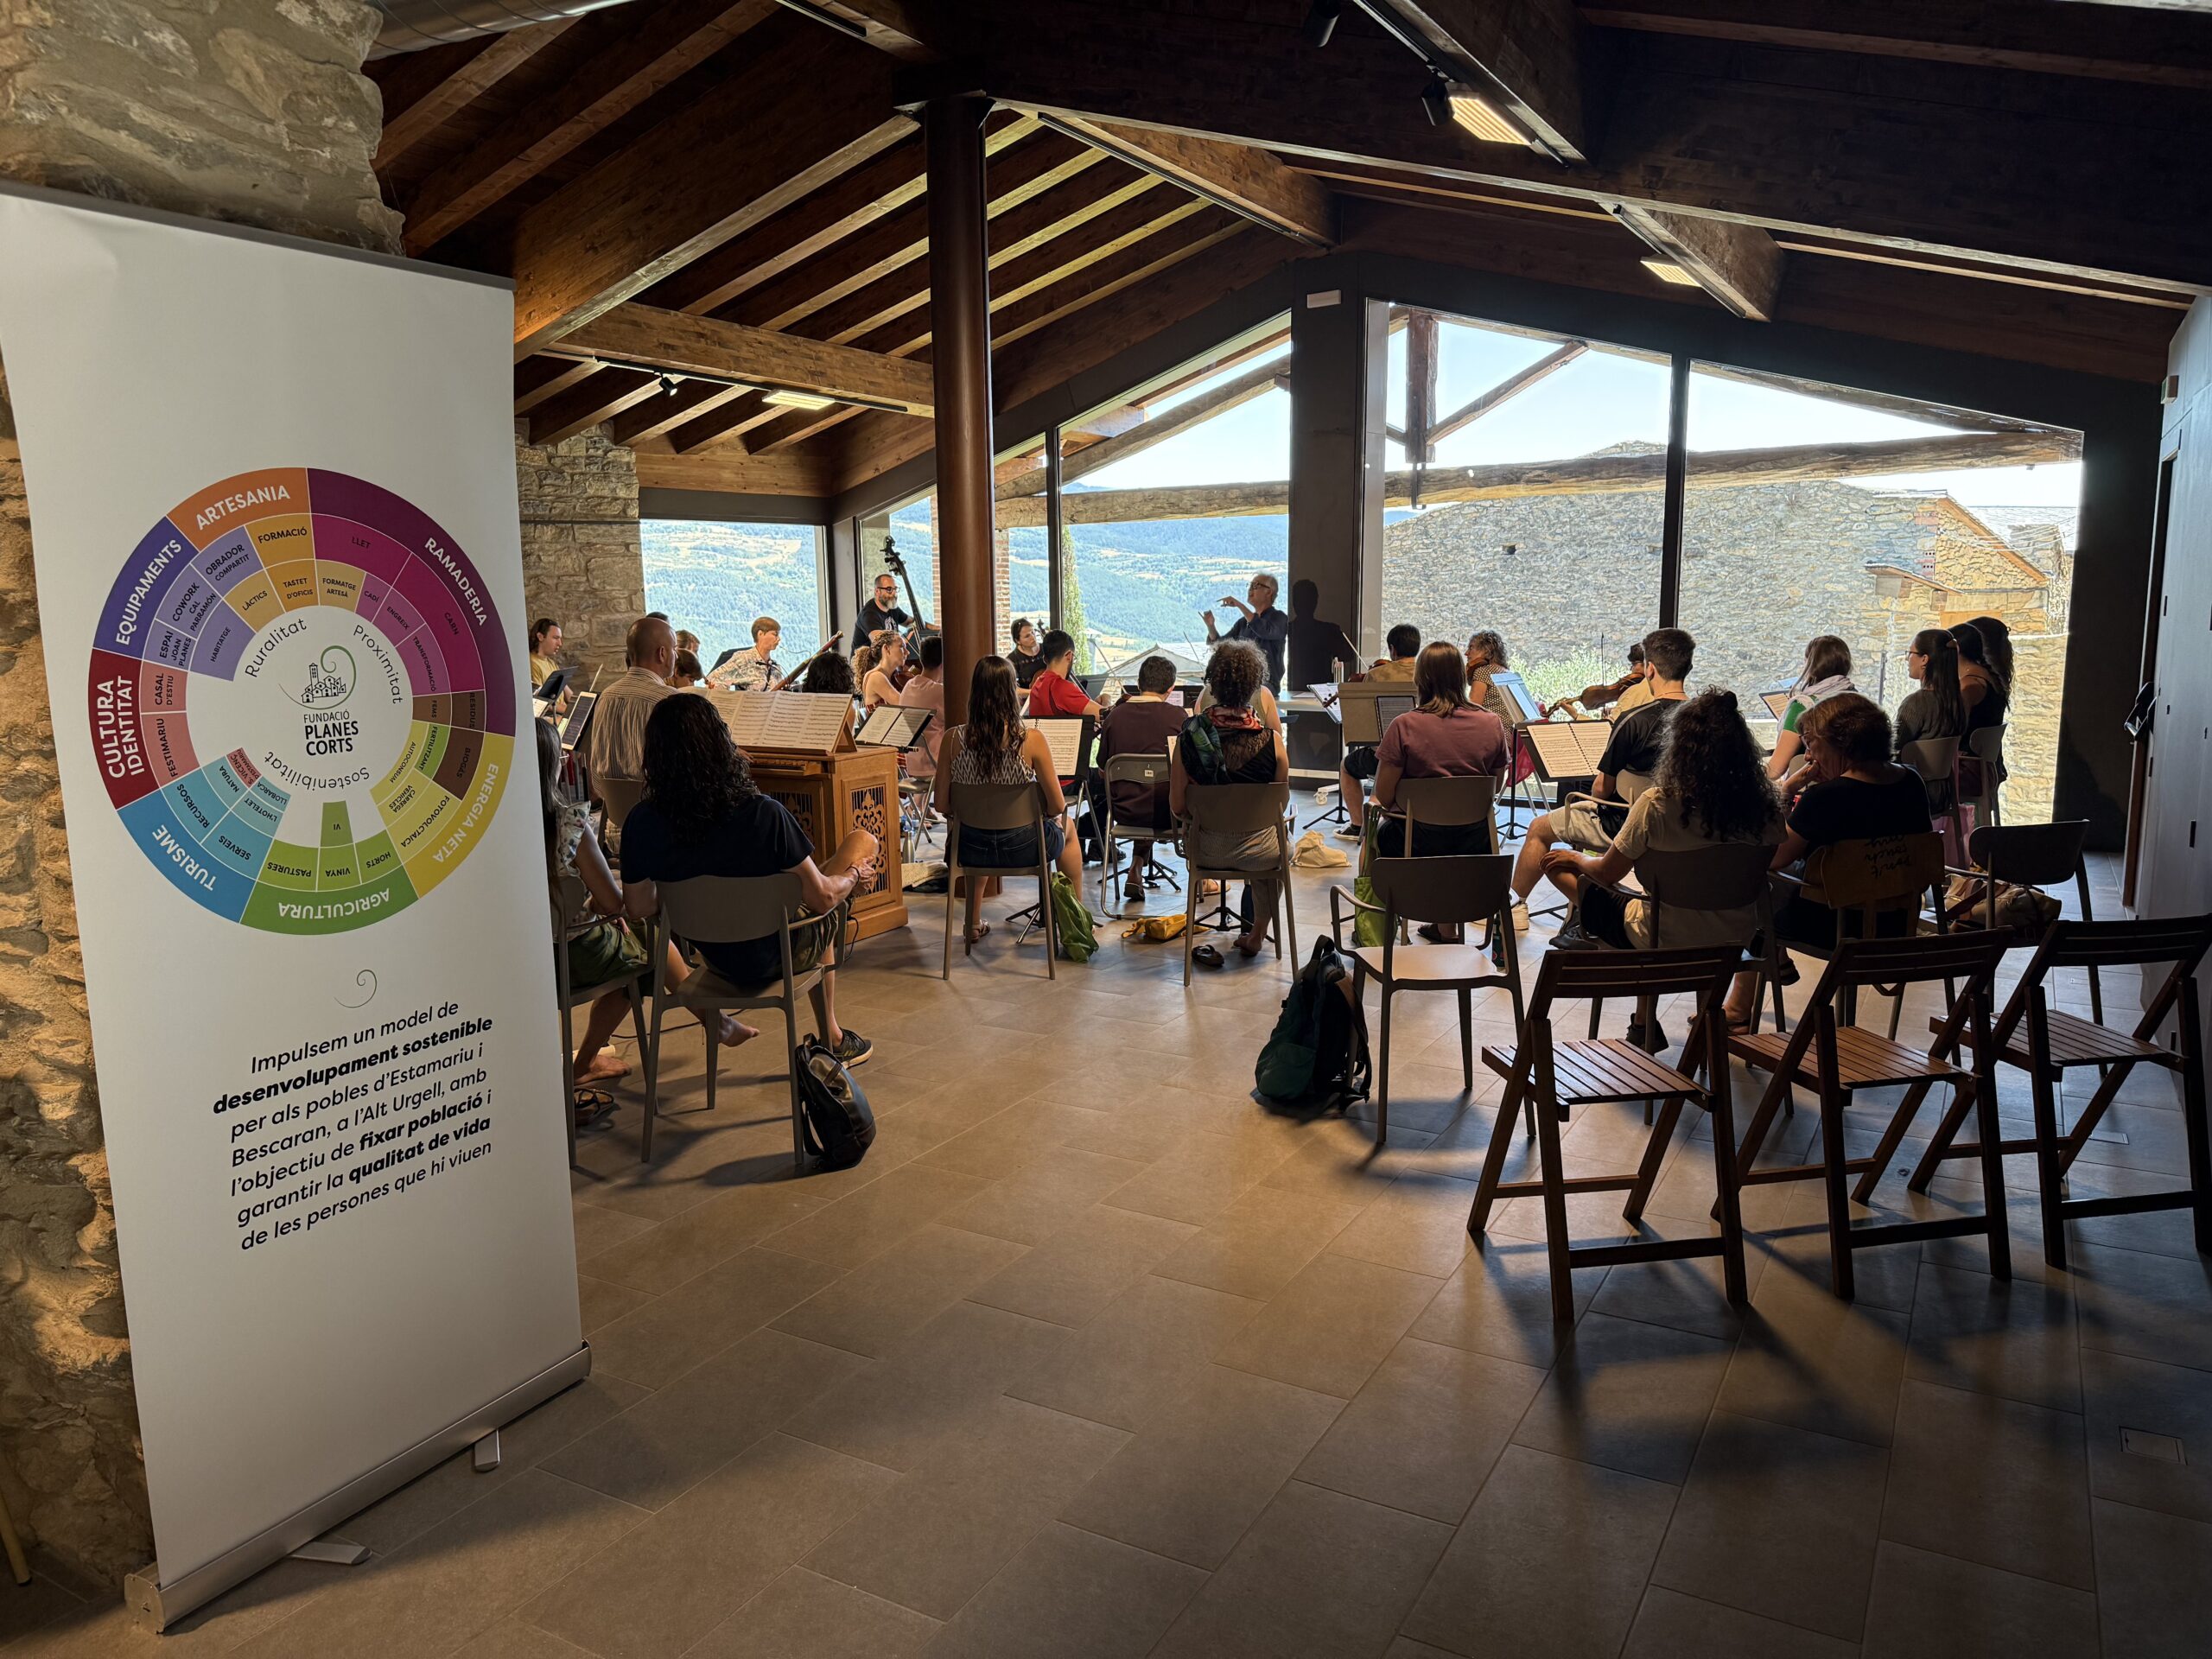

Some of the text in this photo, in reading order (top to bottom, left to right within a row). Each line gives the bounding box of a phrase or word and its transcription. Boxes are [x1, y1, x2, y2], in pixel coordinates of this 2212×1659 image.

[196, 485, 290, 531] ARTESANIA
[258, 527, 307, 543] FORMACIÓ
[353, 537, 371, 549] LLET
[206, 543, 245, 575] OBRADOR
[214, 554, 250, 582] COMPARTIT
[116, 539, 181, 645] EQUIPAMENTS
[283, 578, 308, 588] TASTET
[287, 589, 313, 600] D'OFICIS
[322, 578, 356, 590] FORMATGE
[364, 590, 379, 602] CADÍ
[424, 537, 487, 626] RAMADERIA
[173, 582, 200, 622] COWORK
[189, 601, 200, 614] CAL
[190, 593, 216, 632] PARRAMÓN
[242, 590, 268, 611] LÀCTICS
[387, 606, 410, 630] ENGREIX
[445, 613, 459, 635] CARN
[160, 630, 174, 658] ESPAI
[171, 639, 181, 660] JOAN
[179, 637, 192, 667] PLANES
[210, 626, 231, 662] HABITATGE
[245, 619, 307, 677] Ruralitat
[353, 625, 403, 703] Proximitat
[412, 635, 436, 691] TRANSFORMACIÓ
[155, 672, 164, 705] CASAL
[97, 680, 125, 779] CULTURA
[117, 675, 145, 775] IDENTITAT
[303, 710, 350, 723] FUNDACIÓ
[305, 721, 359, 740] PLANES
[156, 718, 178, 778] FESTIMARIU
[306, 738, 353, 756] CORTS
[390, 741, 416, 784] AUTOCONSUM
[419, 726, 438, 771] FERTILITZANT
[219, 766, 239, 793] NATURA
[230, 753, 250, 780] VICENÇ
[264, 751, 370, 791] Sostenibilitat
[177, 784, 210, 829] RECURSOS
[257, 781, 288, 805] LLOBARCA
[389, 785, 413, 810] VEHICLES
[244, 798, 277, 822] L'HOTELET
[401, 795, 450, 848] FOTOVOLCTAICA
[432, 762, 499, 862] ENERGIA NETA
[152, 823, 217, 891] TURISME
[219, 835, 251, 861] SERVEIS
[365, 851, 391, 868] HORTS
[268, 861, 312, 877] PASTURES
[326, 868, 350, 877] VINYA
[278, 887, 390, 919] AGRICULTURA
[251, 1001, 459, 1073] Impulsem un model de
[213, 1018, 493, 1114] desenvolupament sostenible
[231, 1043, 483, 1143] per als pobles d'Estamariu i
[232, 1124, 331, 1167] Bescaran,
[337, 1117, 348, 1131] a
[393, 1081, 445, 1115] Urgell,
[449, 1068, 486, 1091] amb
[331, 1141, 354, 1161] de
[359, 1122, 404, 1150] fixar
[408, 1091, 483, 1137] població
[487, 1090, 492, 1104] i
[237, 1117, 491, 1228] garantir la qualitat de vida
[241, 1141, 492, 1249] de les persones que hi viuen
